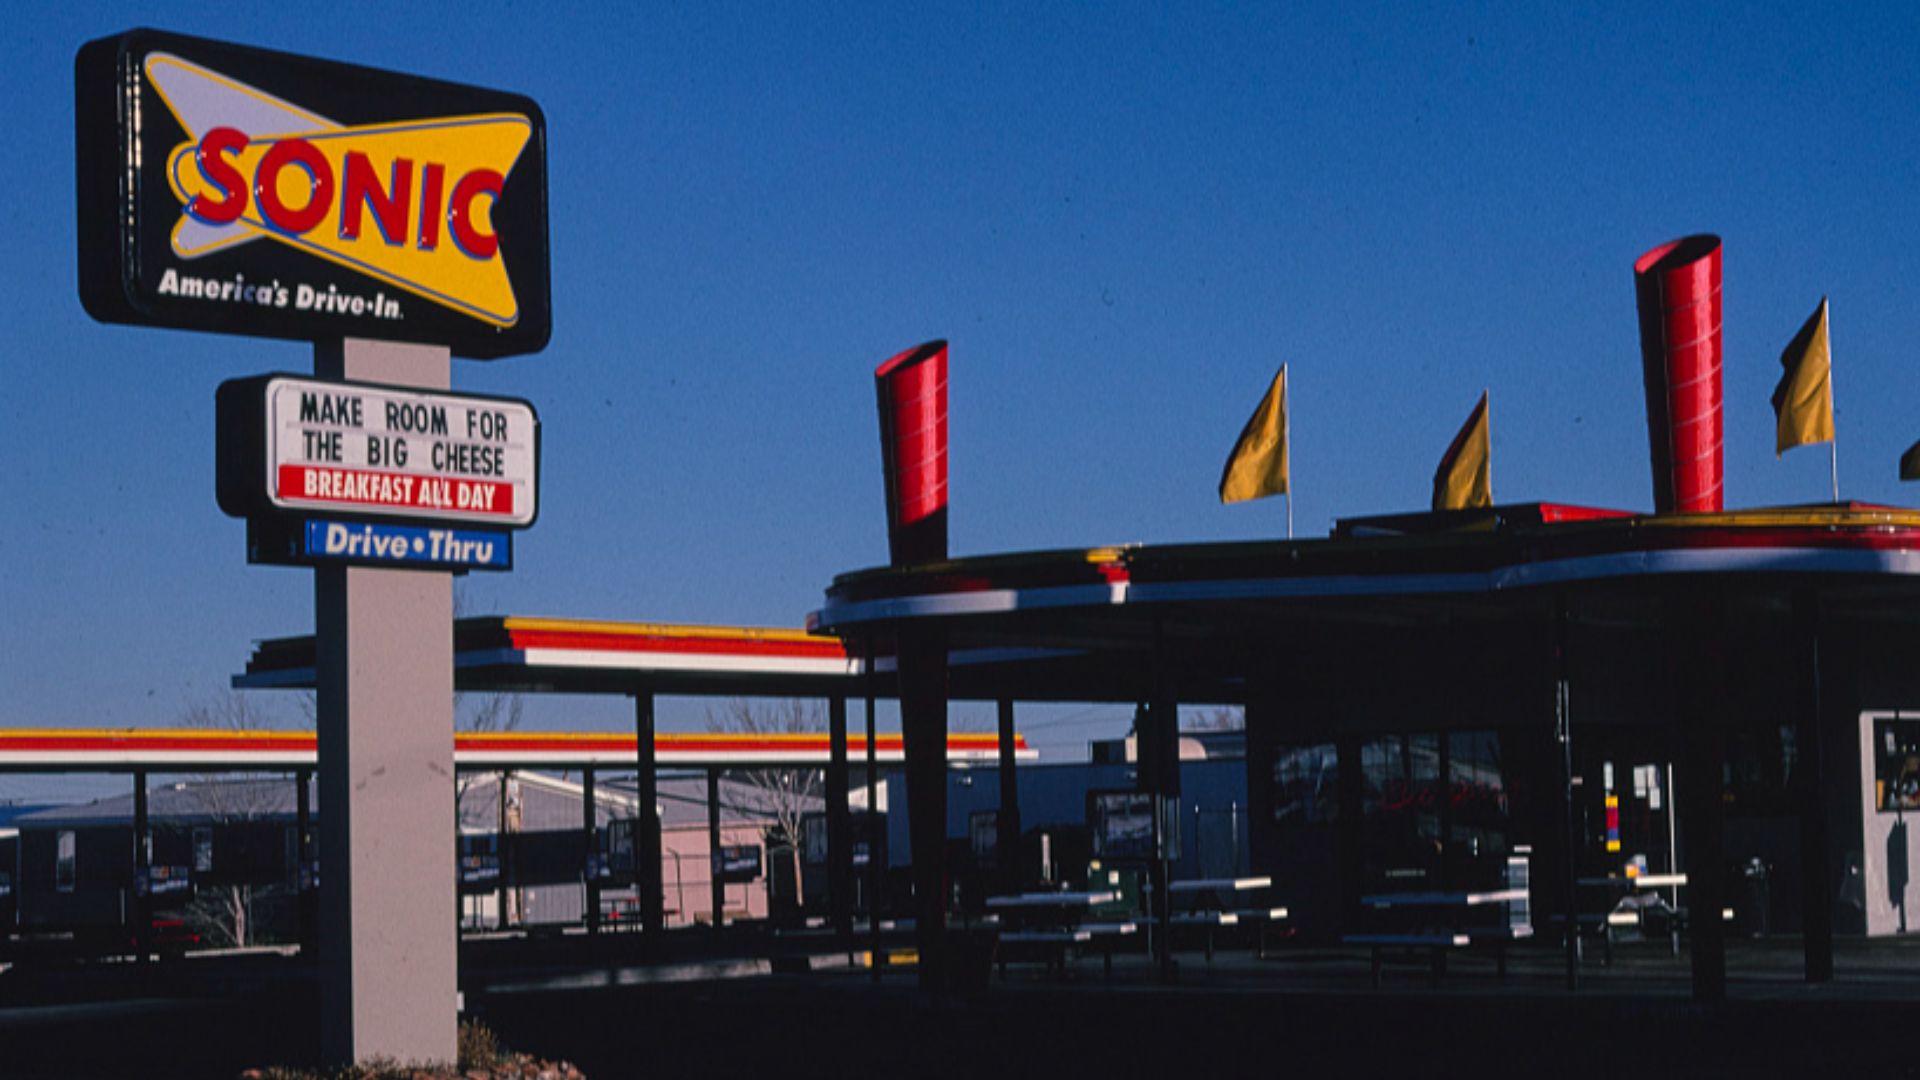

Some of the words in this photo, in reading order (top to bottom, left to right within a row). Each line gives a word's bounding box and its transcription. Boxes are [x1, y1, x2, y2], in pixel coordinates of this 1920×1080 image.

[184, 126, 505, 261] SONIC
[158, 267, 289, 308] America's
[300, 391, 364, 429] MAKE
[385, 400, 449, 436] ROOM
[466, 408, 508, 442] FOR
[303, 428, 343, 463] THE
[367, 434, 408, 468] BIG
[431, 440, 505, 477] CHEESE
[304, 468, 413, 504] BREAKFAST
[418, 477, 453, 507] ALL
[457, 482, 496, 511] DAY
